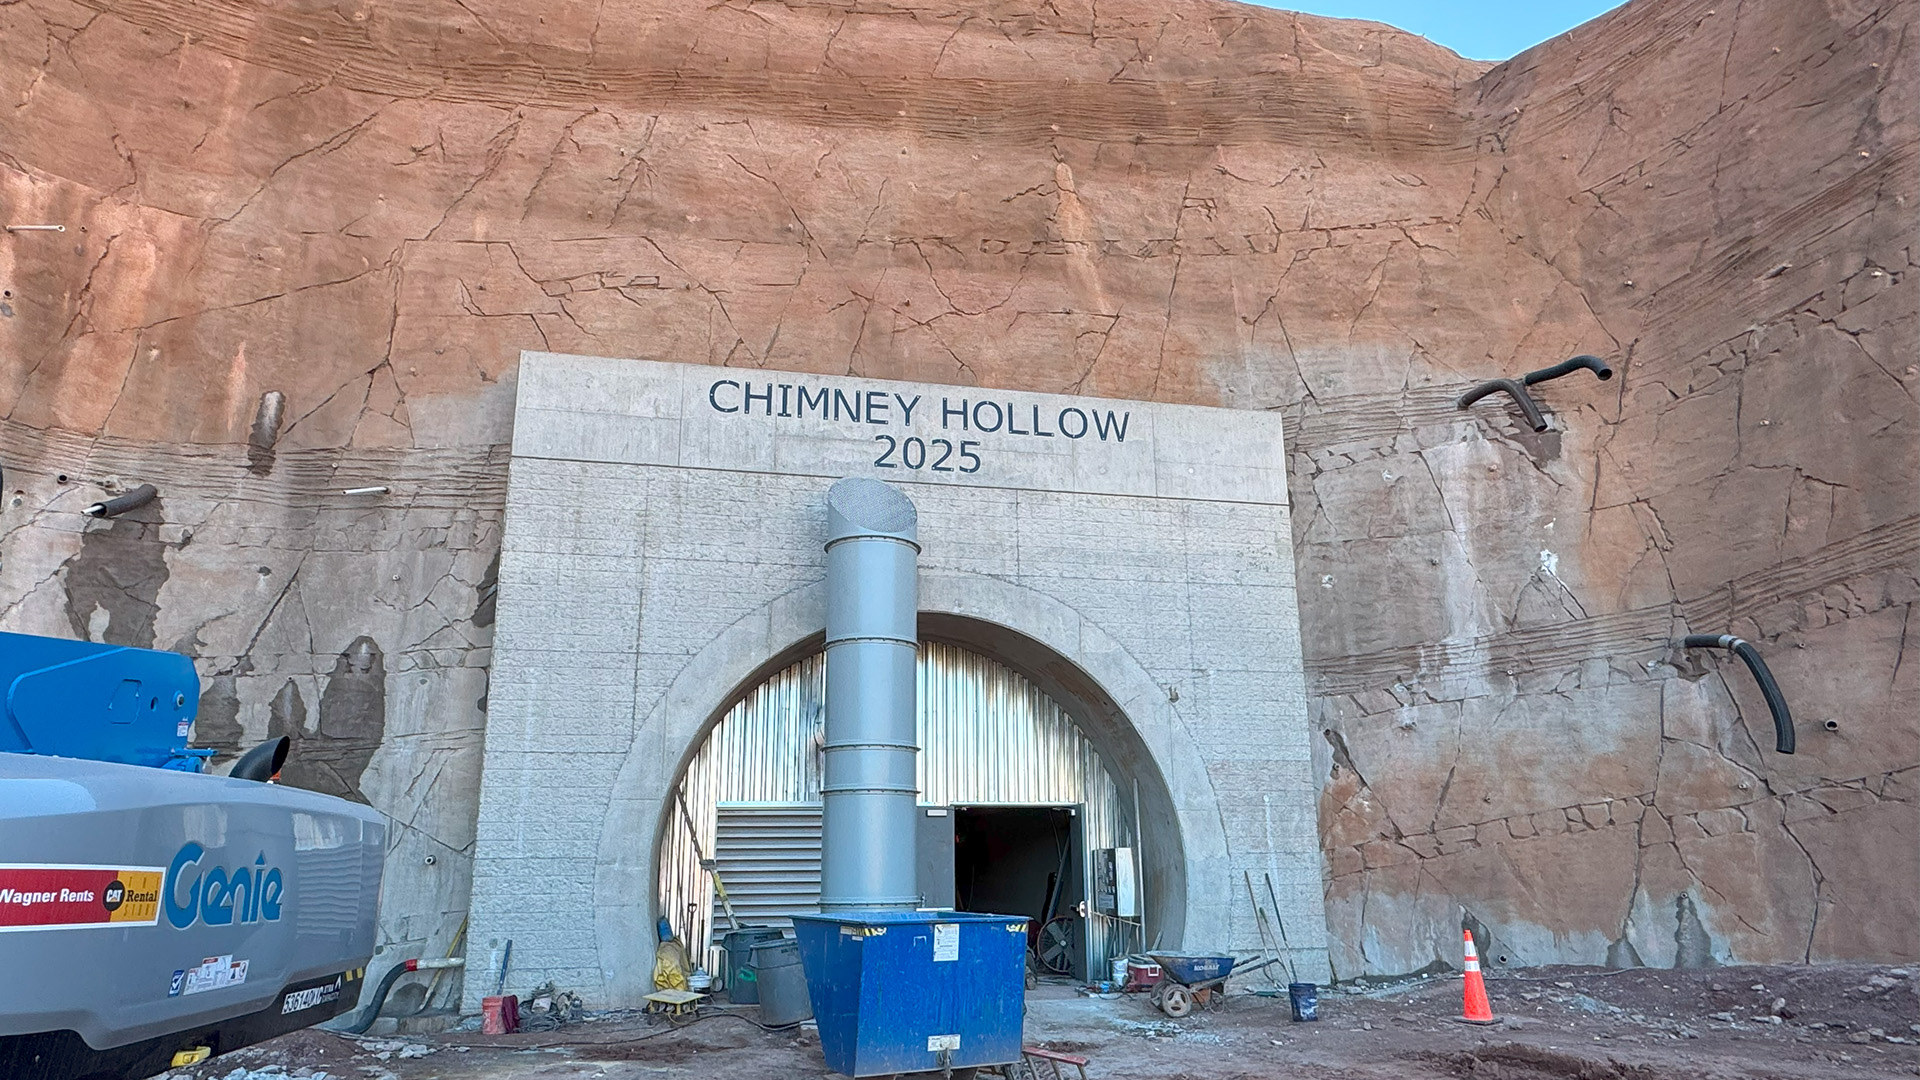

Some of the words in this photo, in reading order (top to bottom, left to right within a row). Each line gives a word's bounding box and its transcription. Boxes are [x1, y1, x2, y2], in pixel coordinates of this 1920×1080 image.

[709, 379, 921, 427] CHIMNEY
[942, 396, 1130, 442] HOLLOW
[873, 434, 982, 474] 2025
[59, 888, 95, 903] Rents
[106, 889, 123, 903] CAT
[126, 889, 159, 902] Rental
[165, 841, 284, 930] Genie
